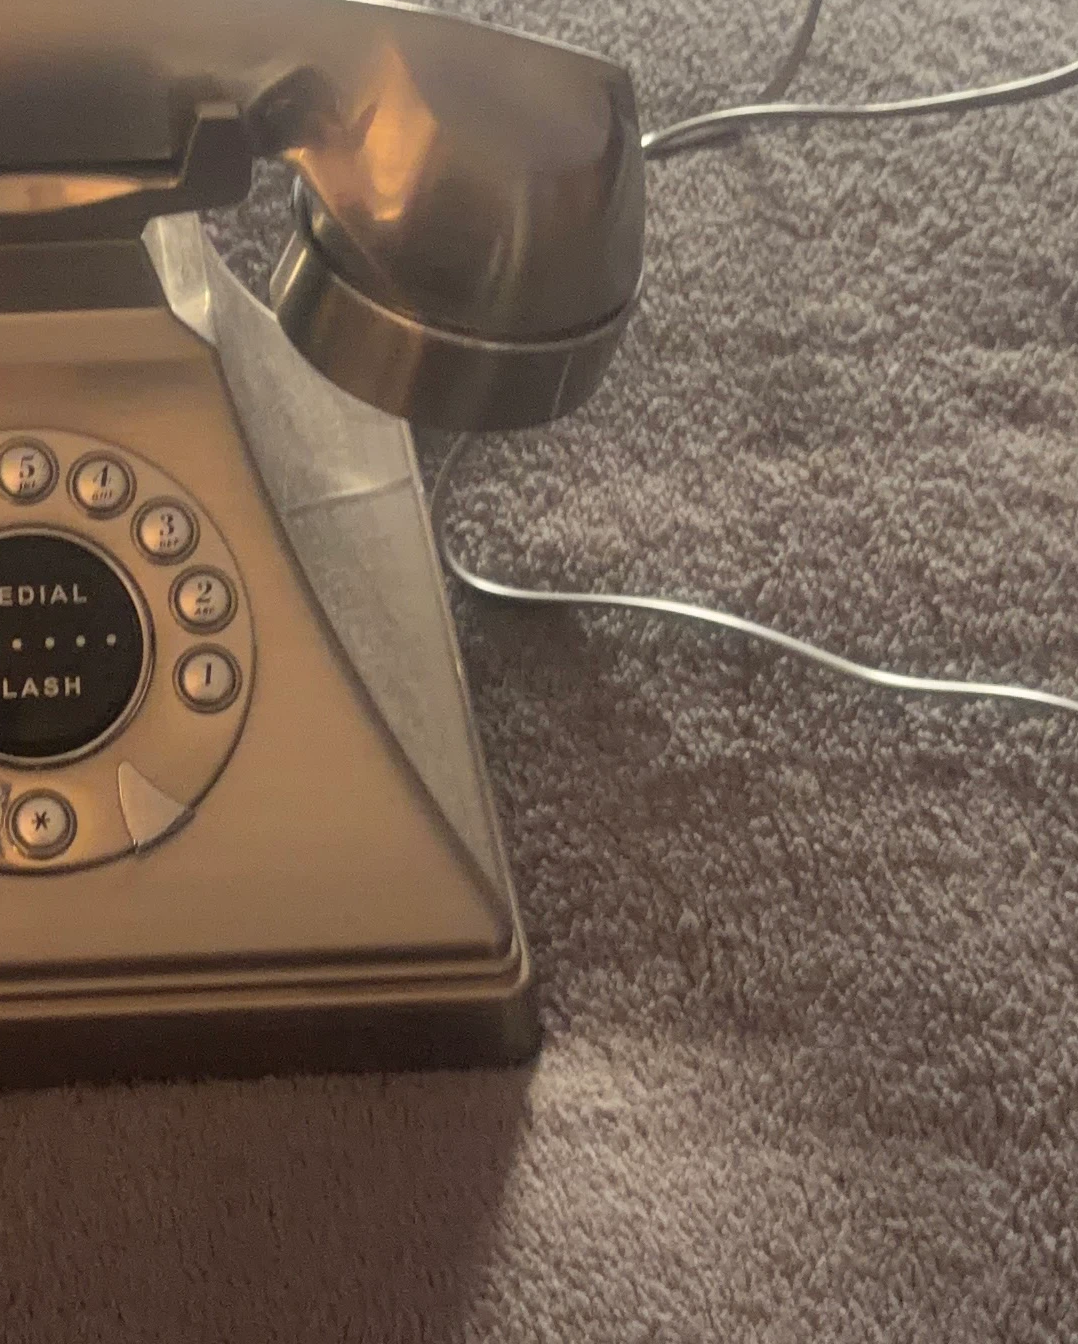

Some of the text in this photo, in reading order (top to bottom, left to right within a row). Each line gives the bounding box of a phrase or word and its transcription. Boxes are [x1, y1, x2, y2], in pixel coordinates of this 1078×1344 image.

[19, 456, 35, 477] 5
[92, 464, 111, 487] 4
[160, 513, 174, 536] 3
[196, 580, 212, 604] 2
[205, 662, 213, 686] 1
